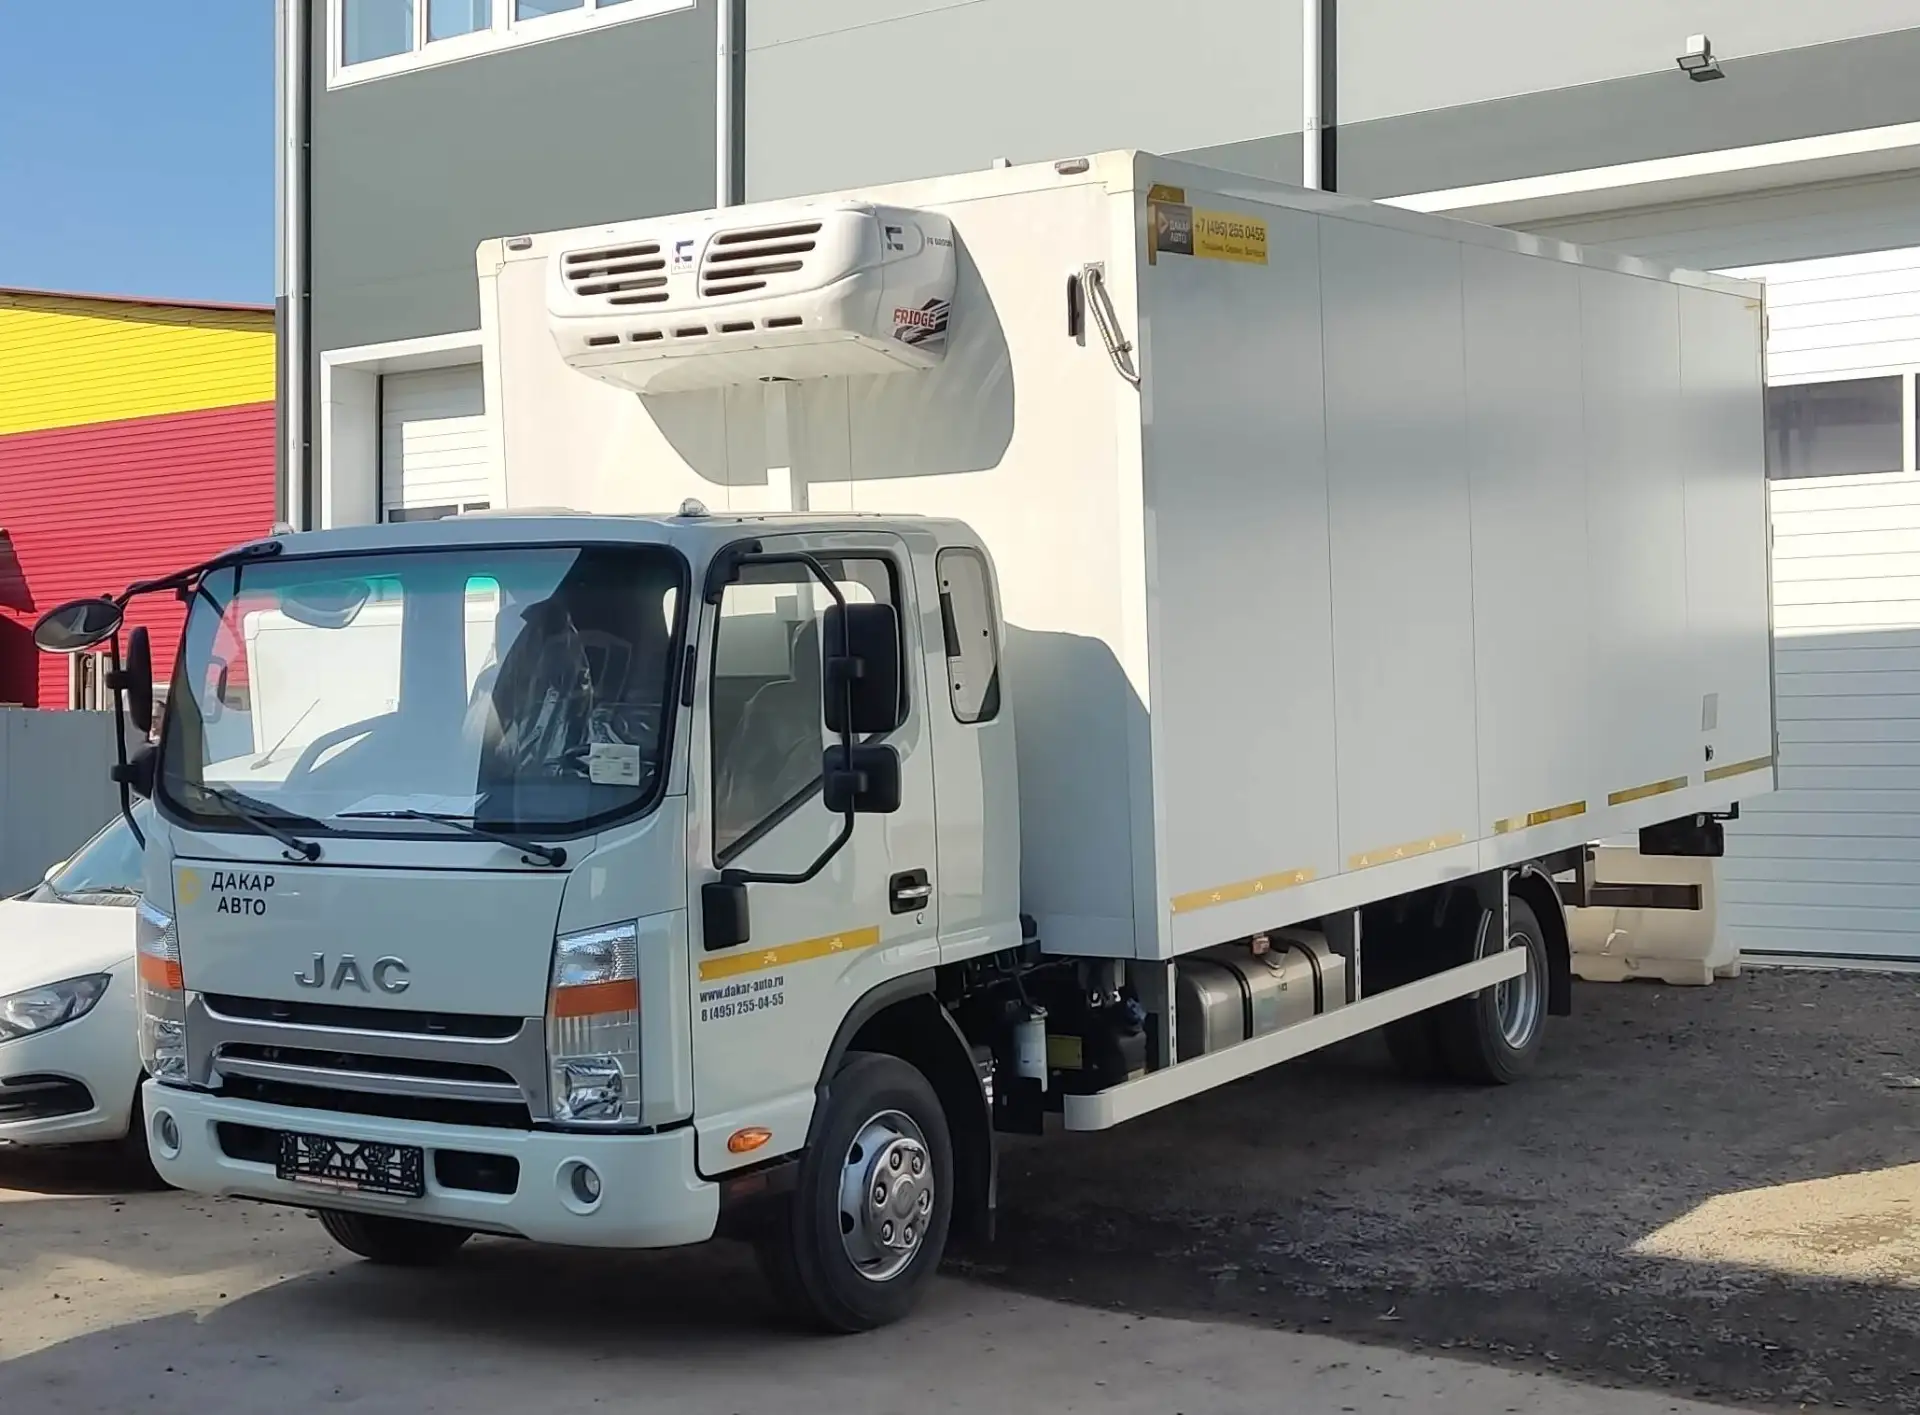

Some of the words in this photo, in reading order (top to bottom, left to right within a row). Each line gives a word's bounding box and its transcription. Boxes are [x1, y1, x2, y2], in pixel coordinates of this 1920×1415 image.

[893, 308, 936, 328] FRIDGE
[211, 872, 276, 892] ДАКАР
[217, 896, 267, 916] АВТО
[294, 952, 411, 995] JAC
[700, 975, 784, 1002] www.dakar-auto.ru
[701, 1009, 708, 1022] 8
[710, 1003, 735, 1020] (495)
[737, 992, 784, 1014] 255-04-55
